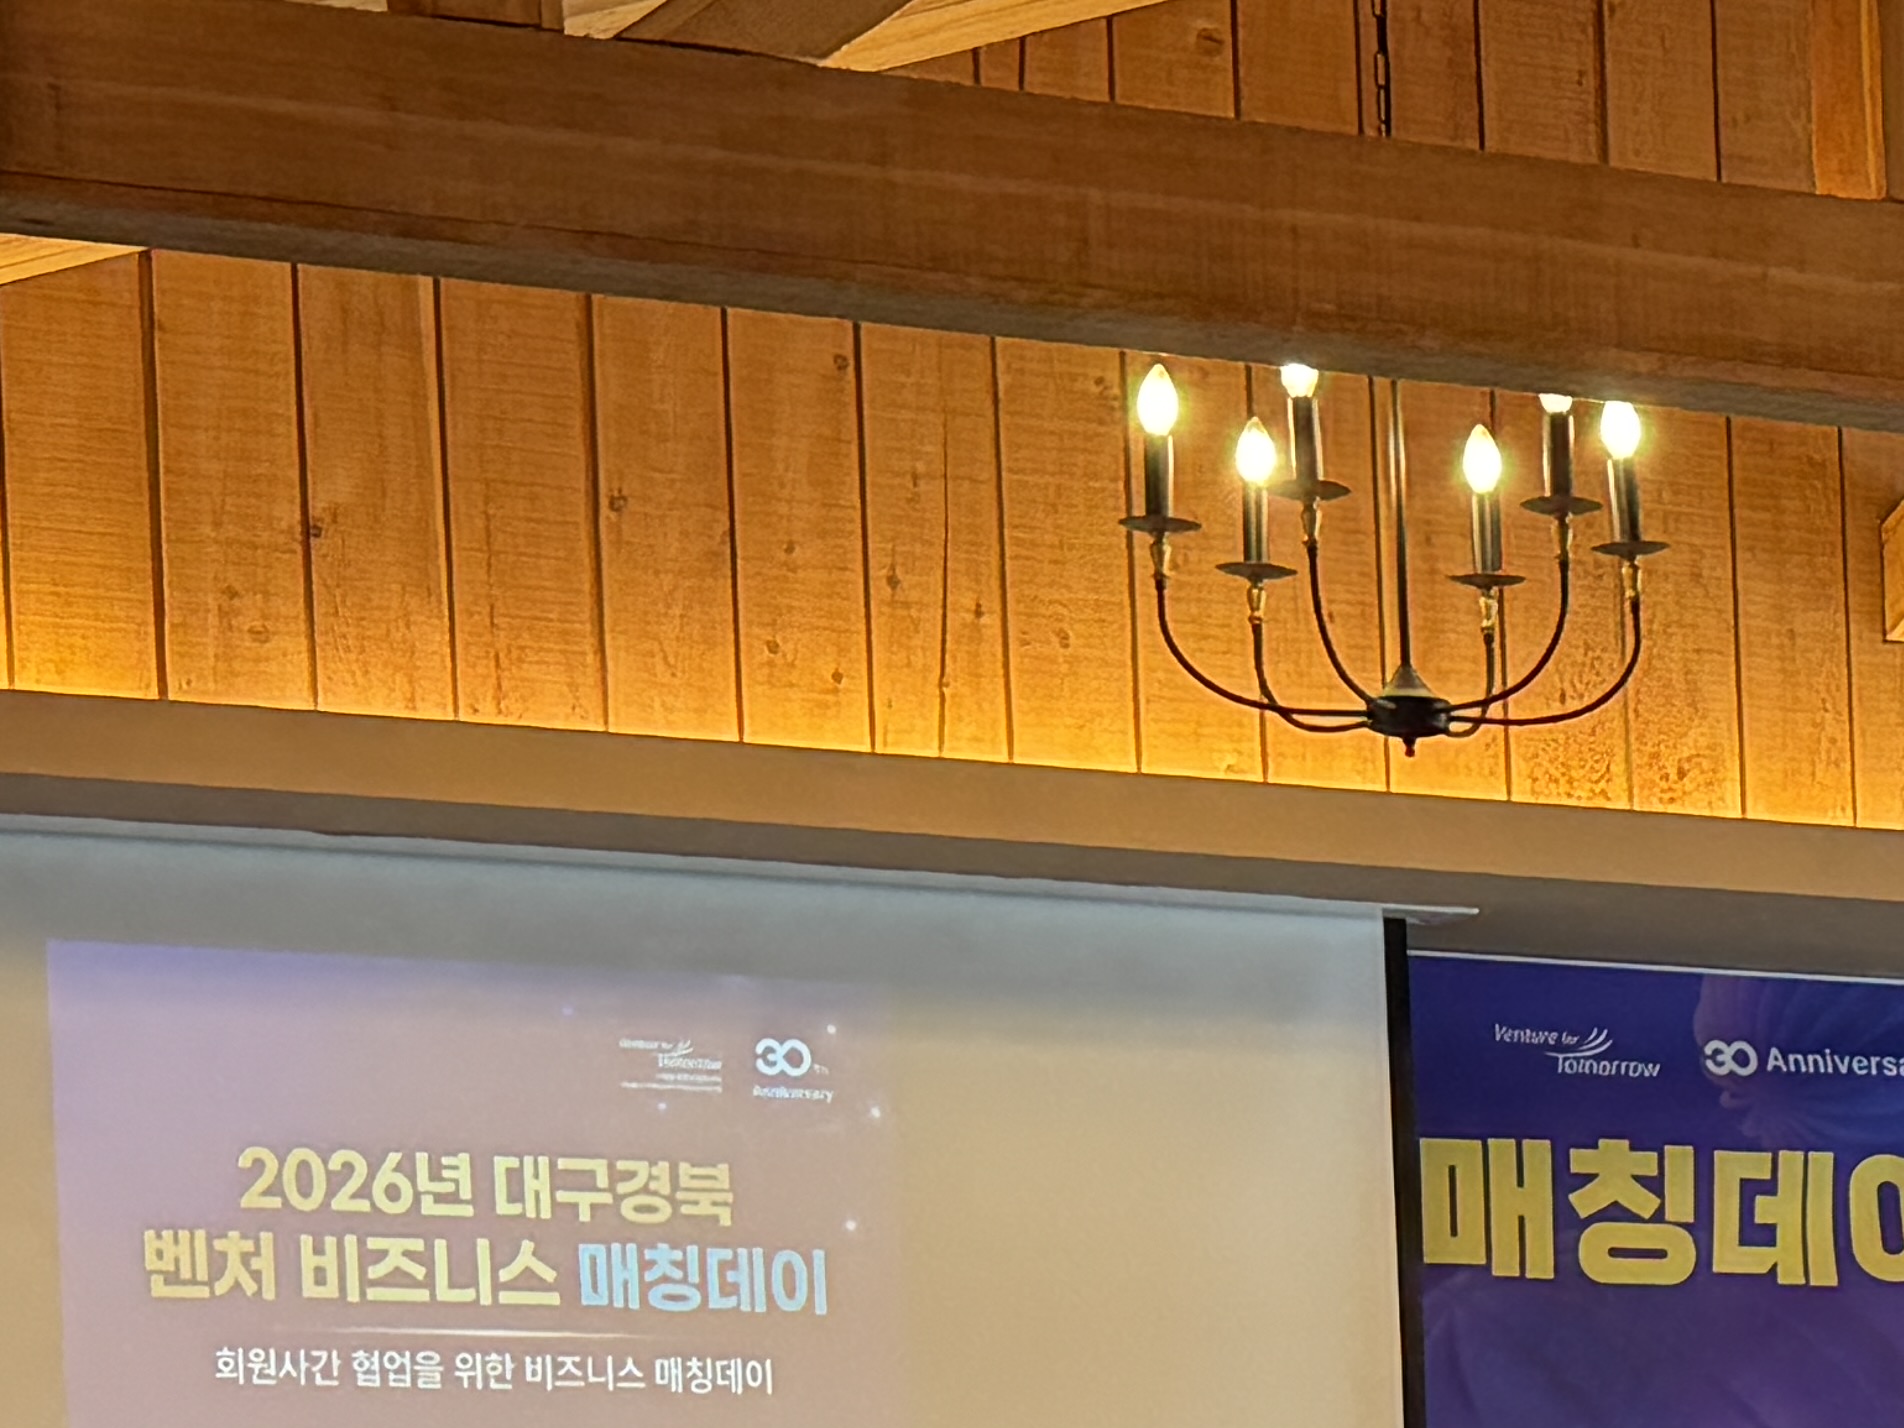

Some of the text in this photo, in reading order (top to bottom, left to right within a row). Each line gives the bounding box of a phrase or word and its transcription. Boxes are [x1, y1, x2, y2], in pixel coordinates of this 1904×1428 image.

[1494, 1023, 1558, 1045] Venture
[1556, 1054, 1661, 1077] Tomorrow
[1704, 1039, 1759, 1077] 30
[237, 1147, 735, 1227] 2026년 대구경북
[143, 1229, 828, 1316] 벤처 비즈니스 매칭데이
[214, 1346, 775, 1396] 회원사간 협업을 위한 비즈니스 매칭데이
